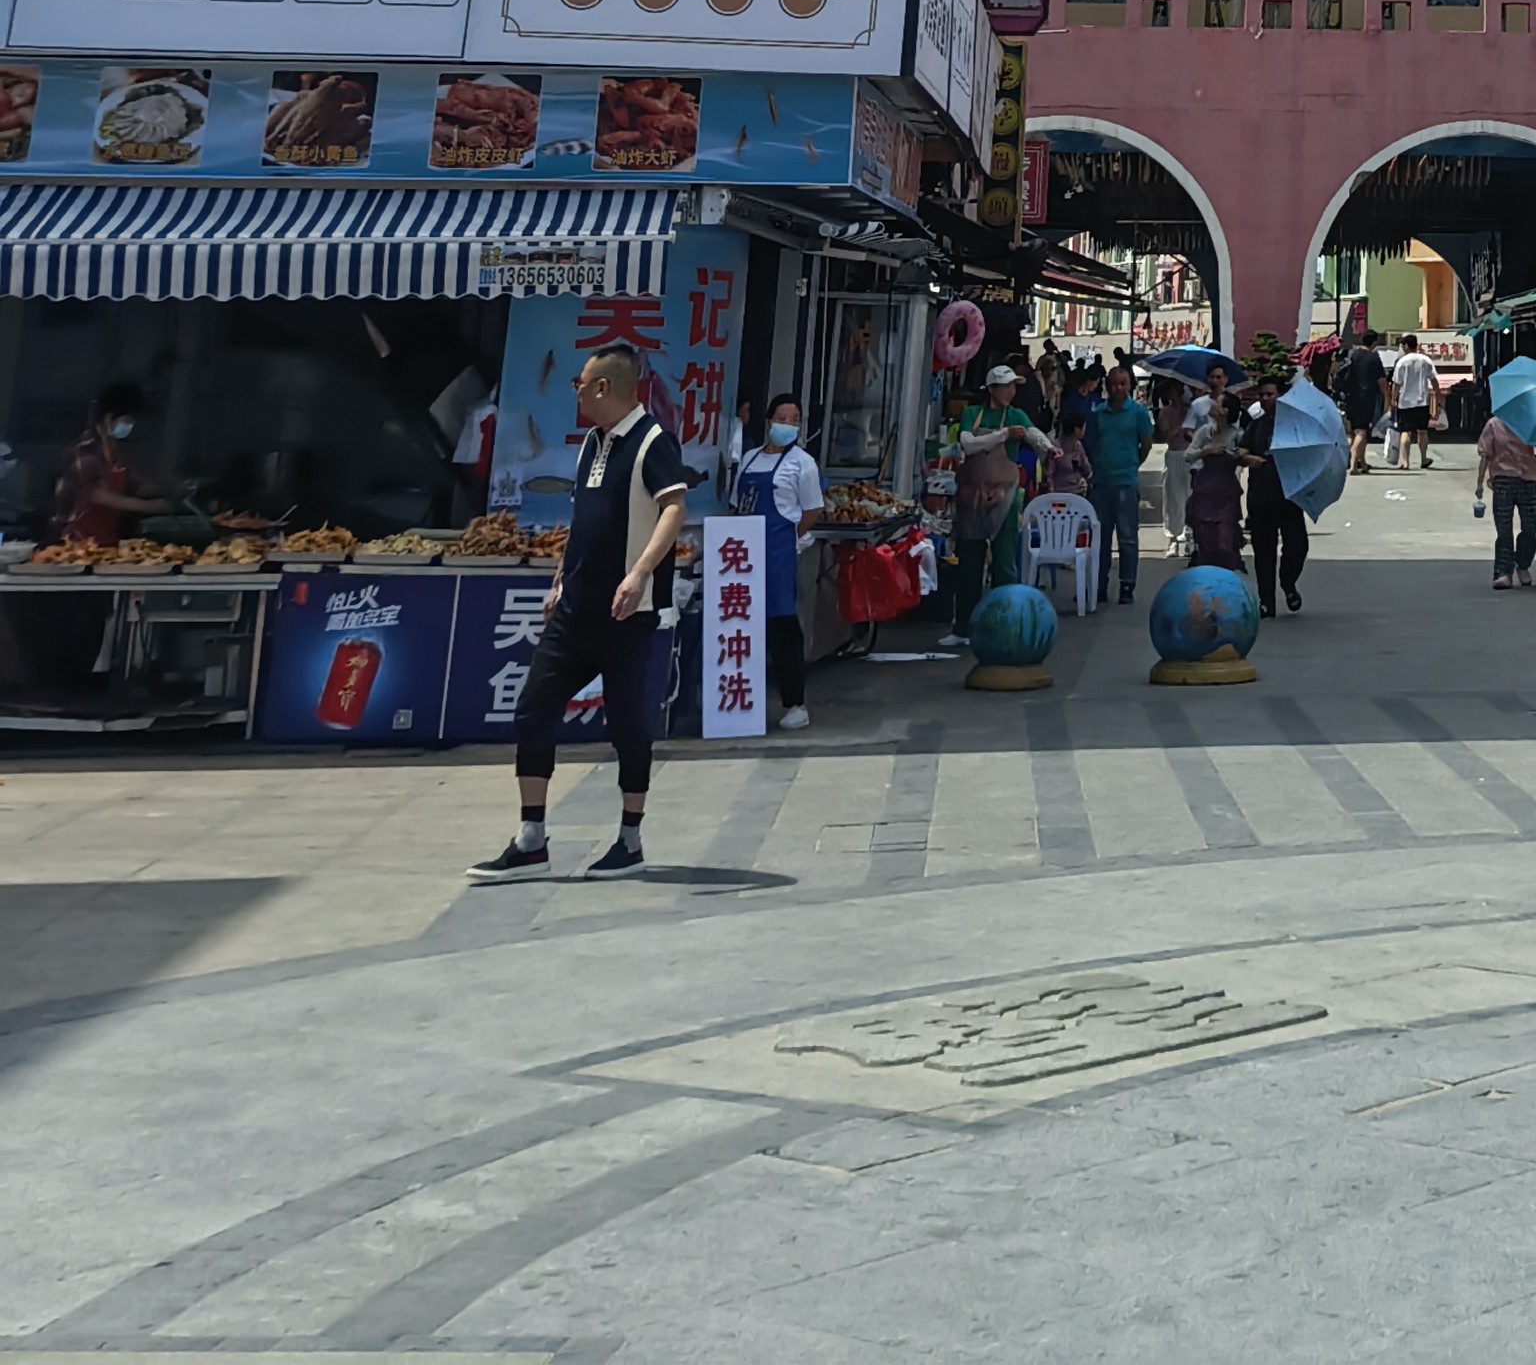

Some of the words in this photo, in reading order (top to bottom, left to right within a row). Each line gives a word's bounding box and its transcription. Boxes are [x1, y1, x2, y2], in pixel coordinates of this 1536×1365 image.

[441, 147, 524, 165] 油炸皮皮虾
[612, 149, 677, 167] 油炸大虾
[499, 265, 606, 286] 13656530603
[717, 536, 754, 713] 免费冲洗
